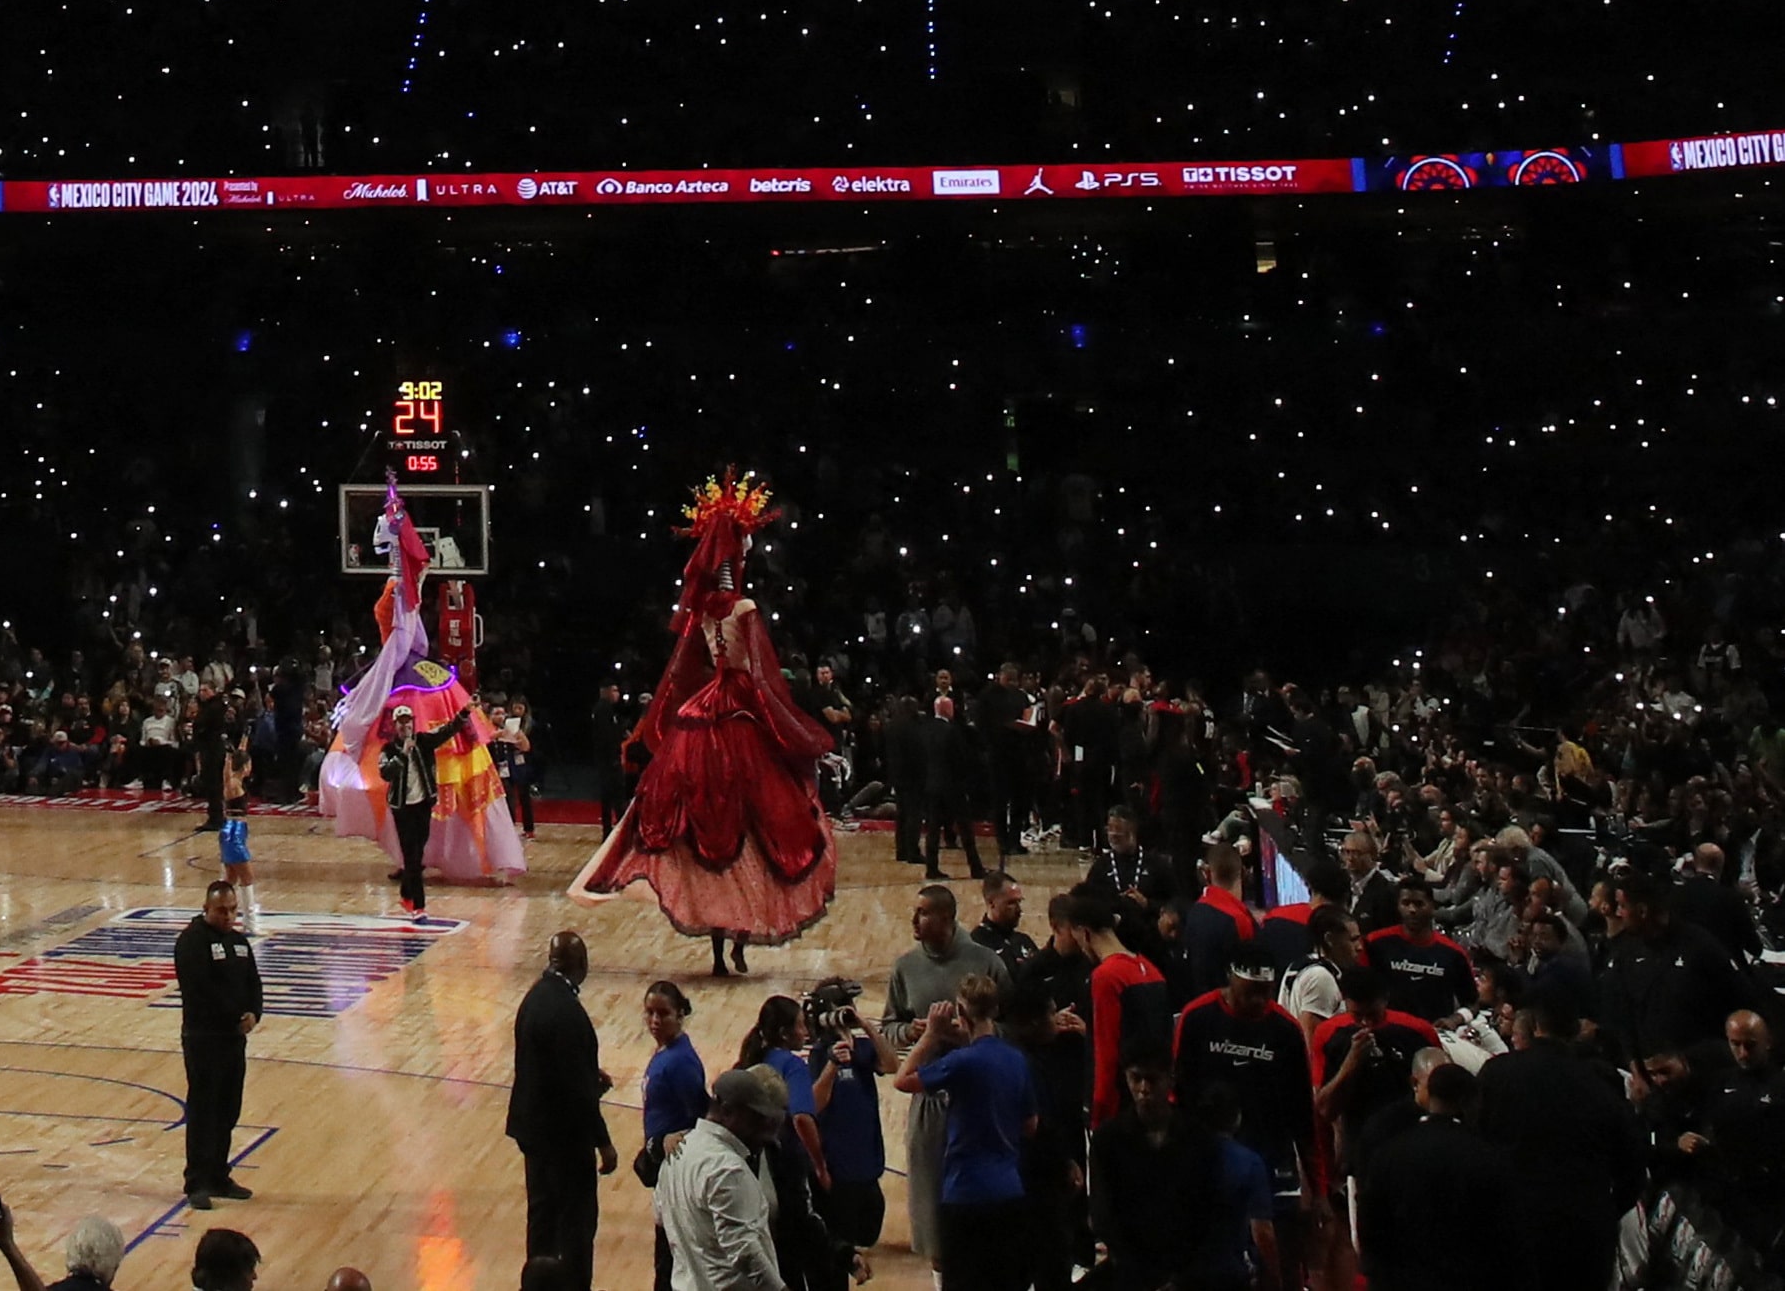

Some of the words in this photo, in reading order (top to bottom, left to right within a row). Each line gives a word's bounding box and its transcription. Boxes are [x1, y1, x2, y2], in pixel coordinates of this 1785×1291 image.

[1683, 138, 1737, 169] MEXICO
[1737, 134, 1770, 165] CITY
[1104, 173, 1162, 187] PS5
[1215, 166, 1296, 182] TISSOT
[343, 182, 408, 199] Michelob
[436, 184, 497, 195] ULTRA
[539, 181, 578, 195] AT&T
[626, 180, 673, 194] Banco
[675, 179, 729, 193] Azteca
[750, 178, 811, 192] betcris
[851, 176, 910, 192] elektra
[939, 176, 993, 189] Emirates
[61, 183, 110, 208] MEXICO
[112, 183, 143, 207] CITY
[144, 182, 180, 207] GAME
[182, 181, 218, 206] 2024
[401, 381, 442, 400] 9:02
[395, 401, 439, 433] 24
[404, 441, 447, 449] TISSOT
[408, 456, 437, 470] 0:55
[1391, 959, 1445, 976] wizards
[1209, 1039, 1274, 1061] wizards
